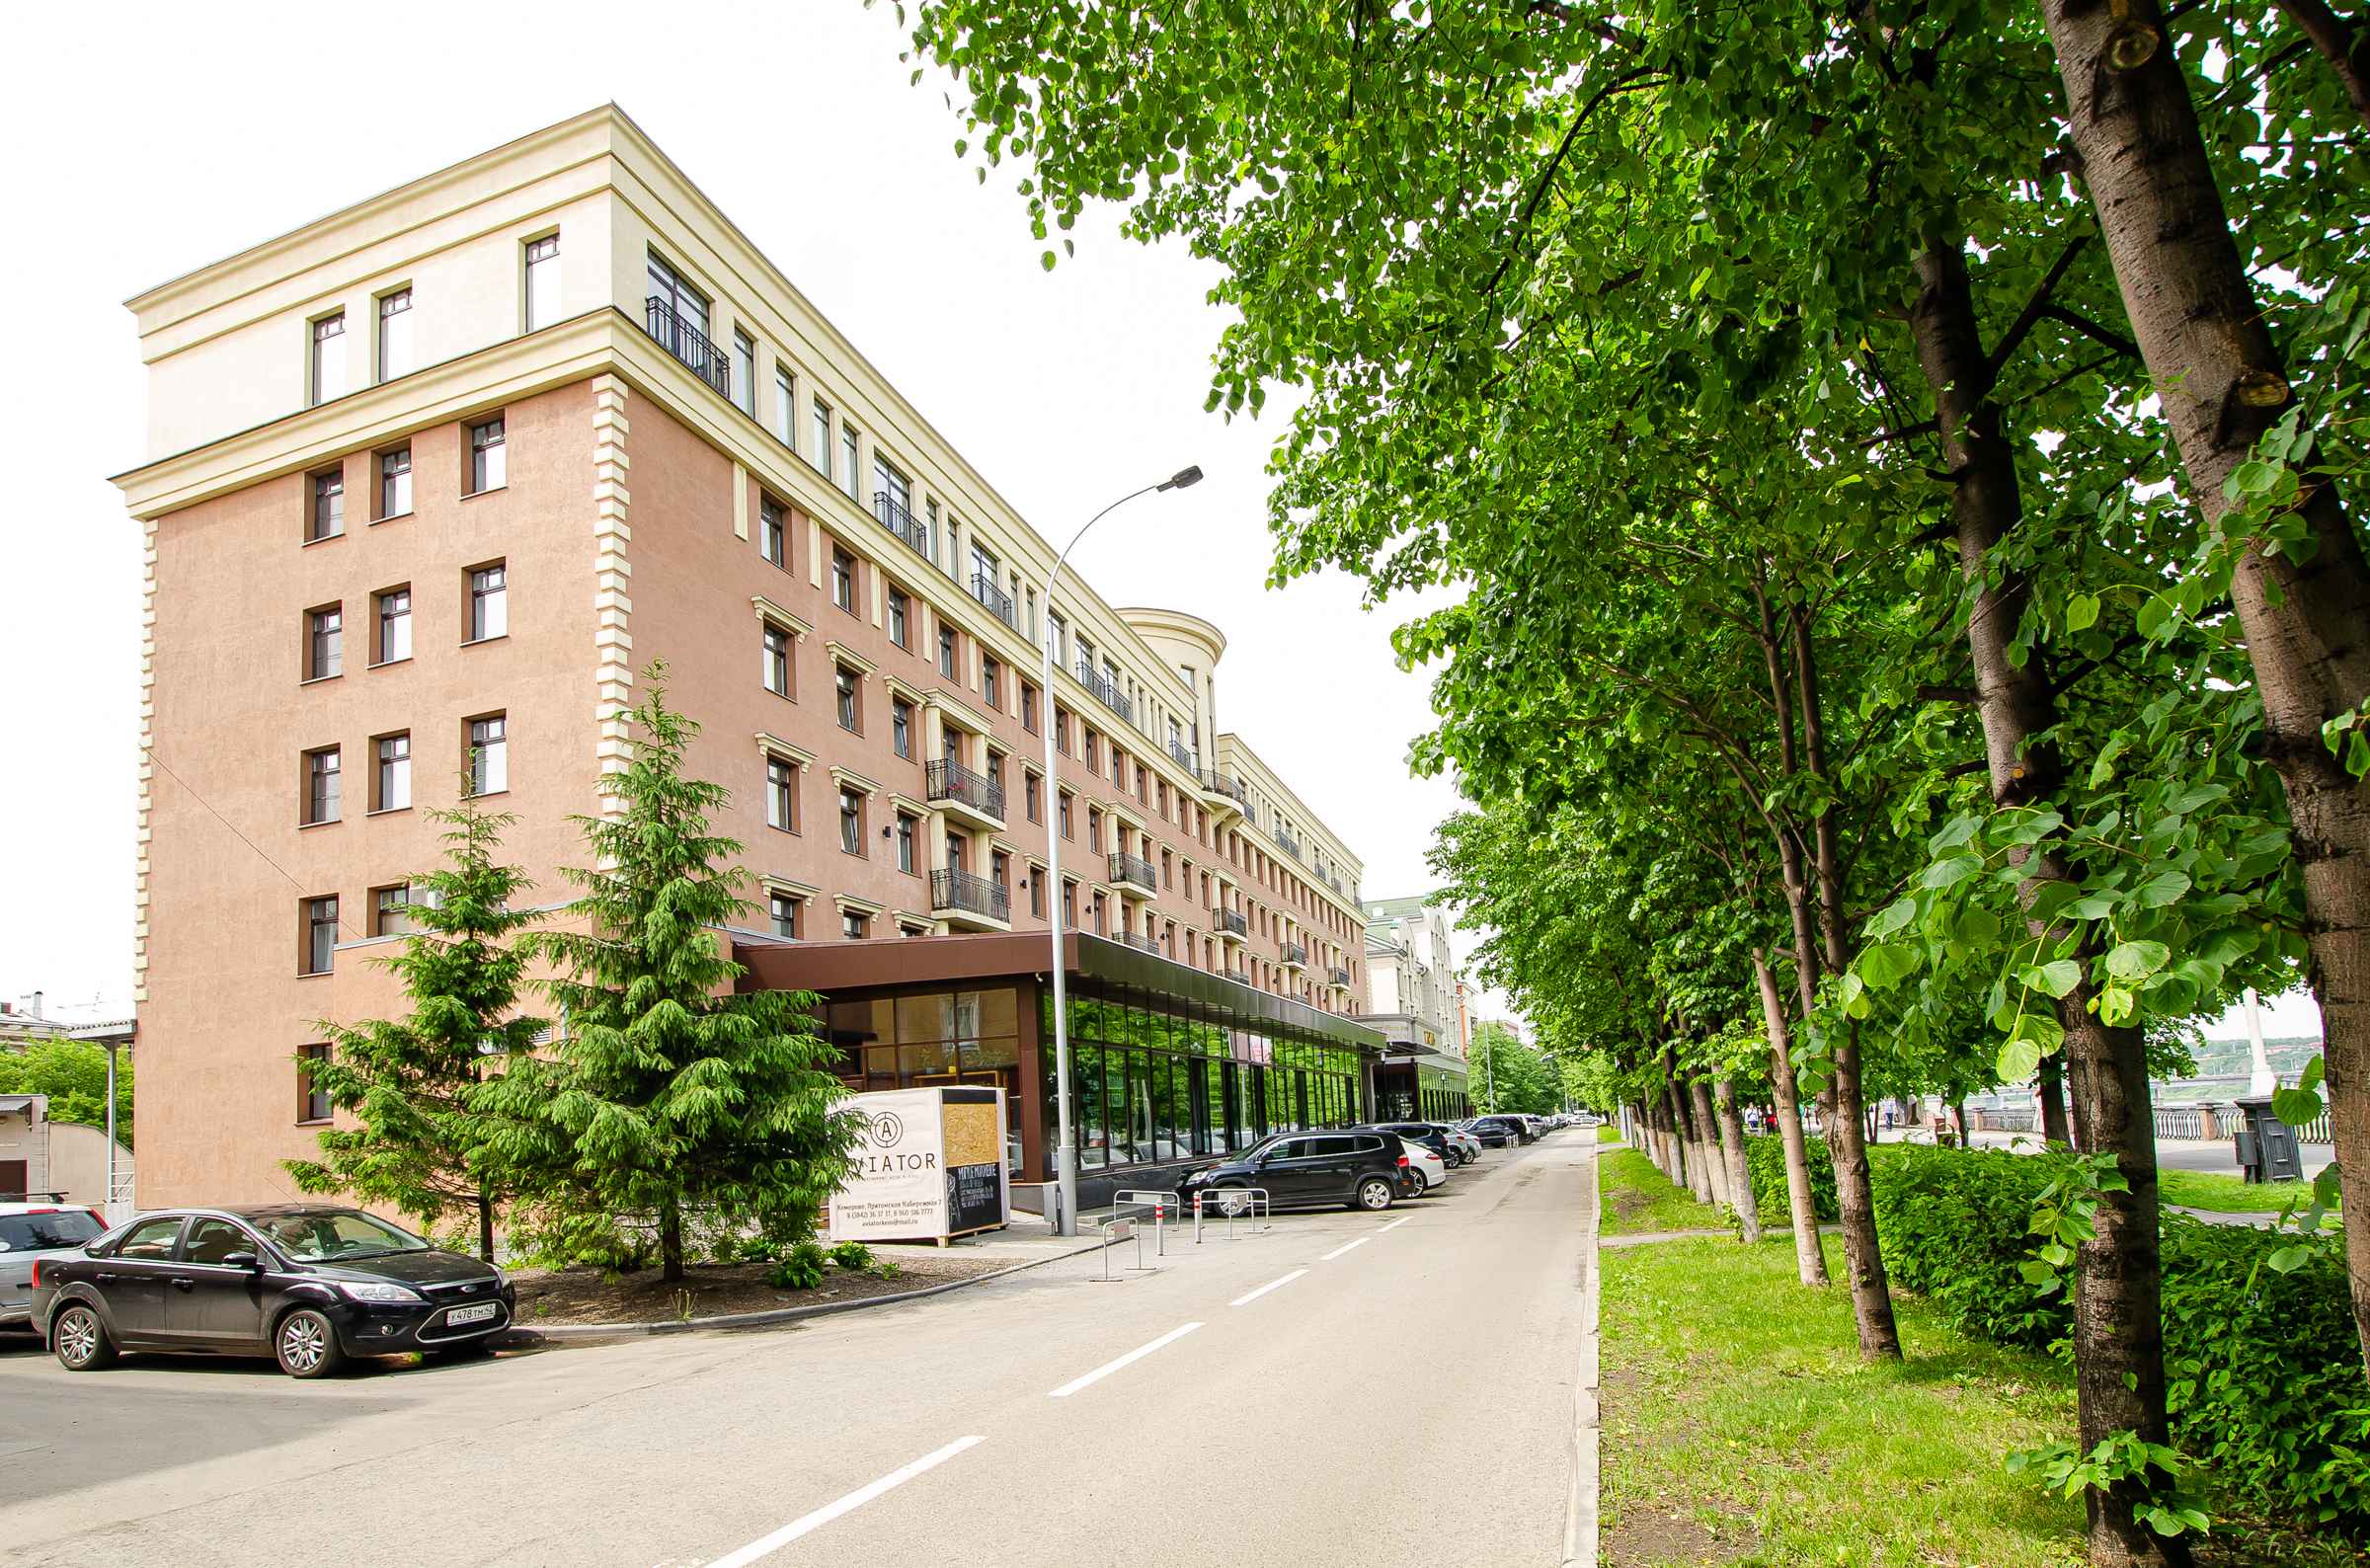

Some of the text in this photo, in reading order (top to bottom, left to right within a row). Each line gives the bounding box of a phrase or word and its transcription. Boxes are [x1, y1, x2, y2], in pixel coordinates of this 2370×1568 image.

[882, 1121, 892, 1137] A
[853, 1153, 936, 1173] VIATOR
[862, 1218, 918, 1227] aviatorkem@mail.ru
